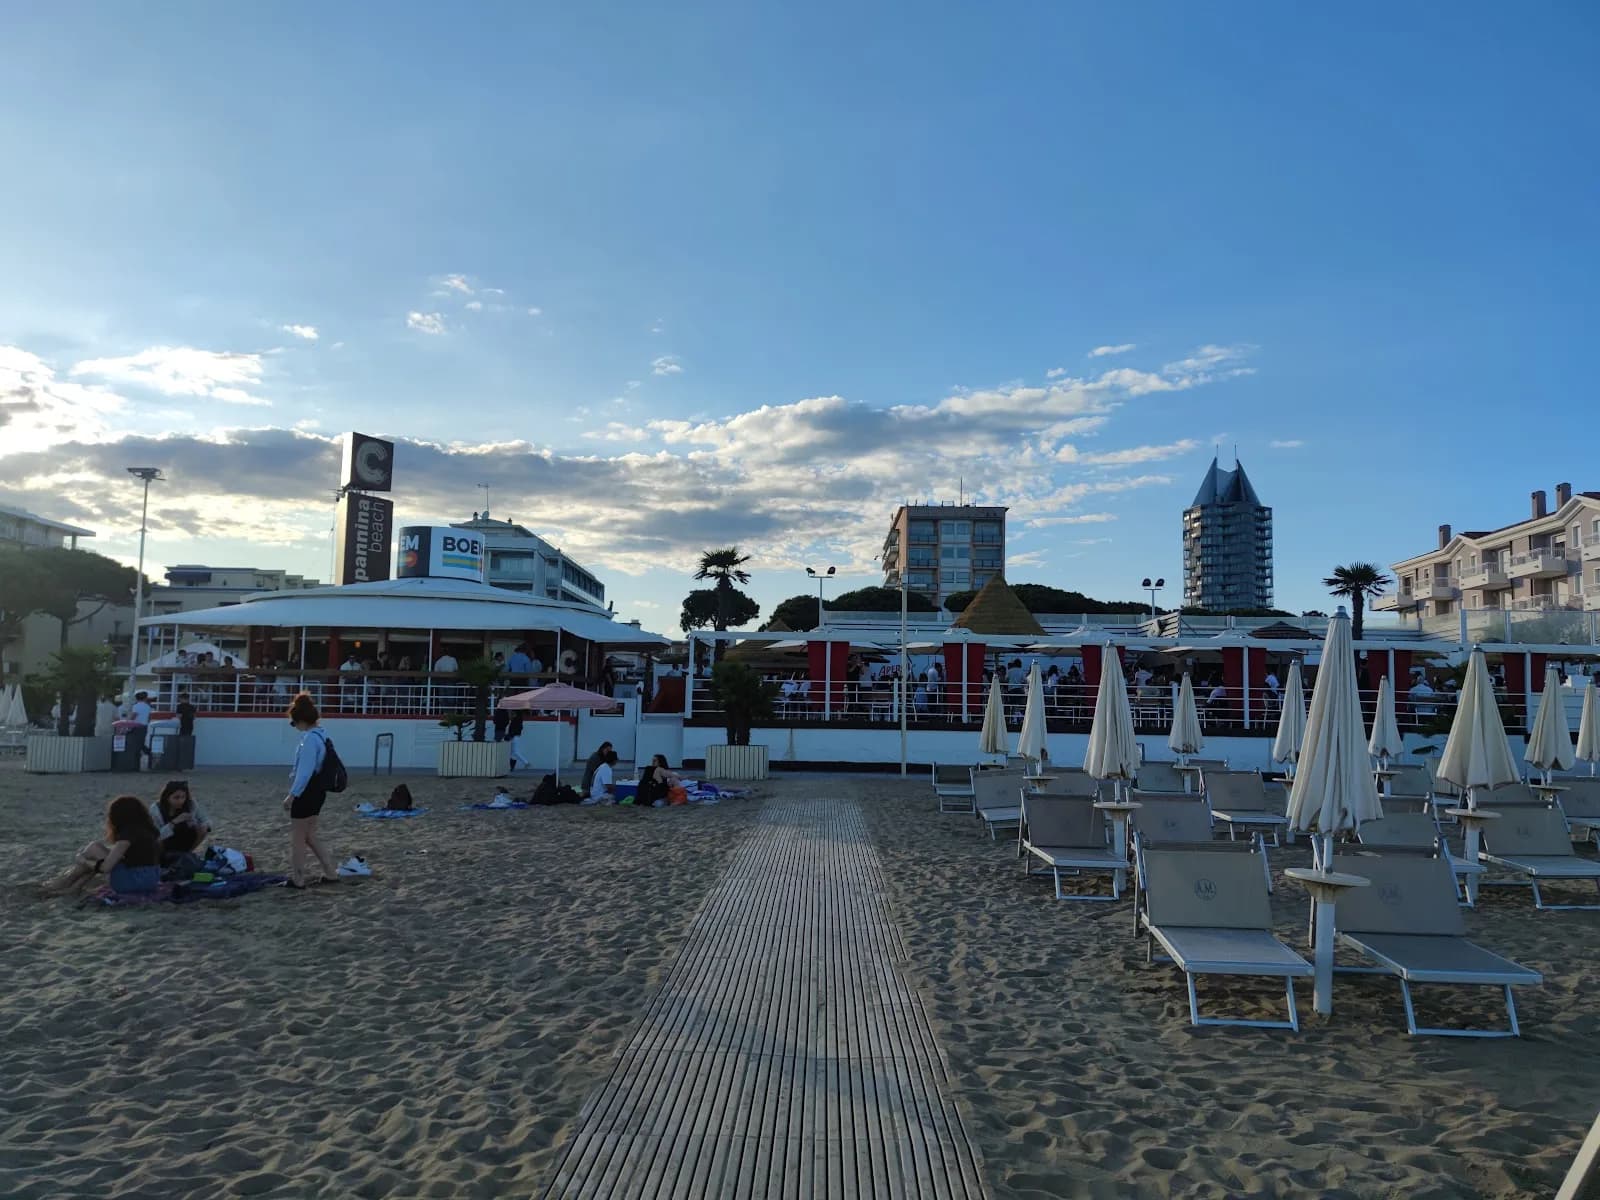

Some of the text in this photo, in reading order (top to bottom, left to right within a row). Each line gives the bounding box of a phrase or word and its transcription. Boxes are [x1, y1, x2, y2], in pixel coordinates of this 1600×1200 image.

[356, 440, 387, 485] C
[354, 499, 370, 581] pannina
[368, 502, 385, 553] beach
